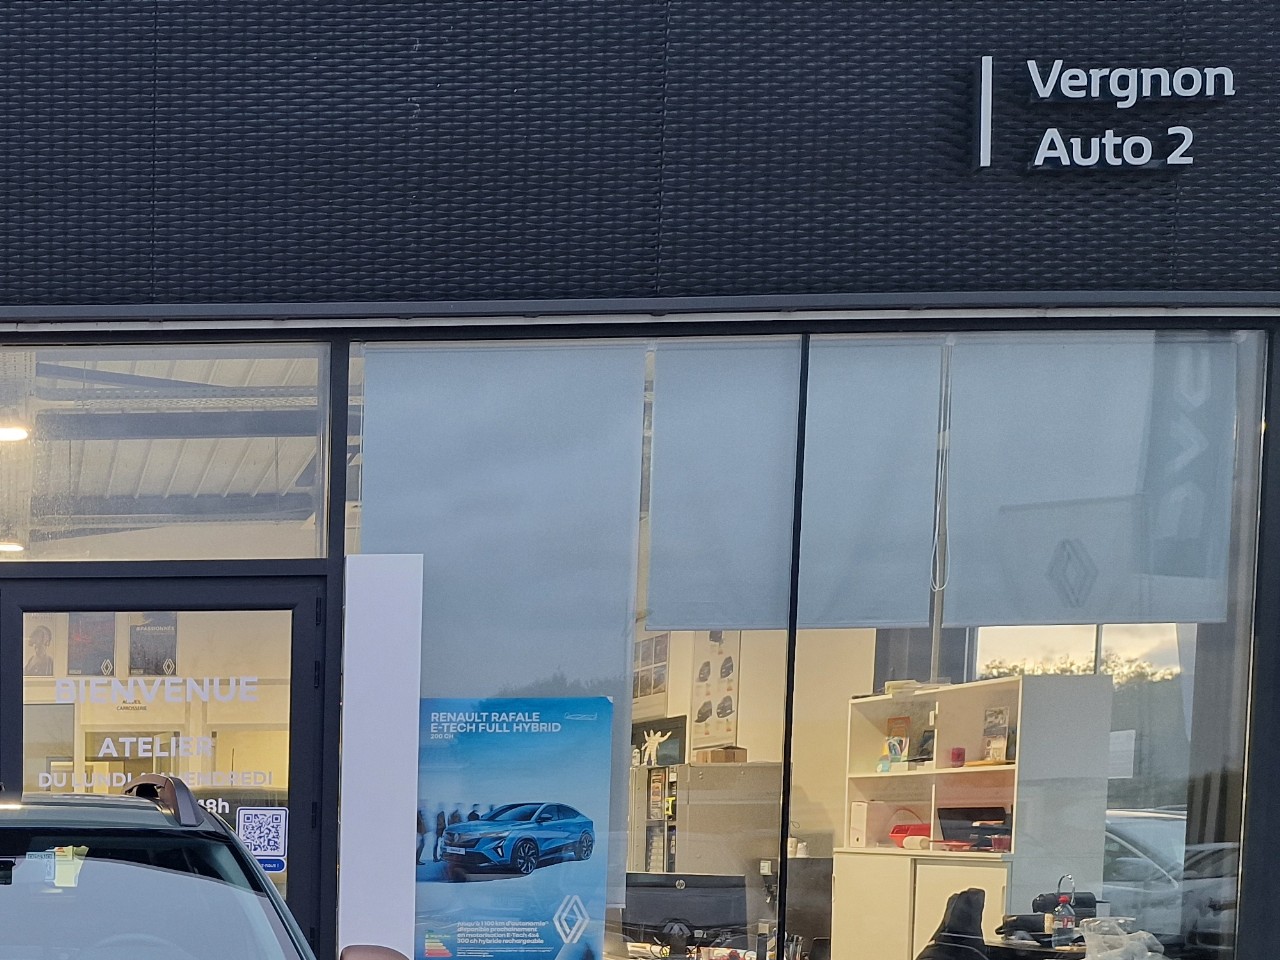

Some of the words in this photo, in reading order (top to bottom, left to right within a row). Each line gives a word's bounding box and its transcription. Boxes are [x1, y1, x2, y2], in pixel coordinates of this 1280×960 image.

[1026, 59, 1235, 109] Vergnon
[1033, 127, 1153, 167] Auto
[1166, 125, 1194, 165] 2
[55, 676, 258, 703] BIENVENUE
[431, 712, 488, 722] RENAULT
[491, 712, 540, 722] RAFALE
[431, 723, 475, 732] E-TECH
[478, 723, 510, 732] FULL
[513, 722, 561, 732] HYBRID
[98, 737, 213, 757] ATELIER
[39, 772, 66, 788] DU
[72, 772, 131, 787] LUNDI
